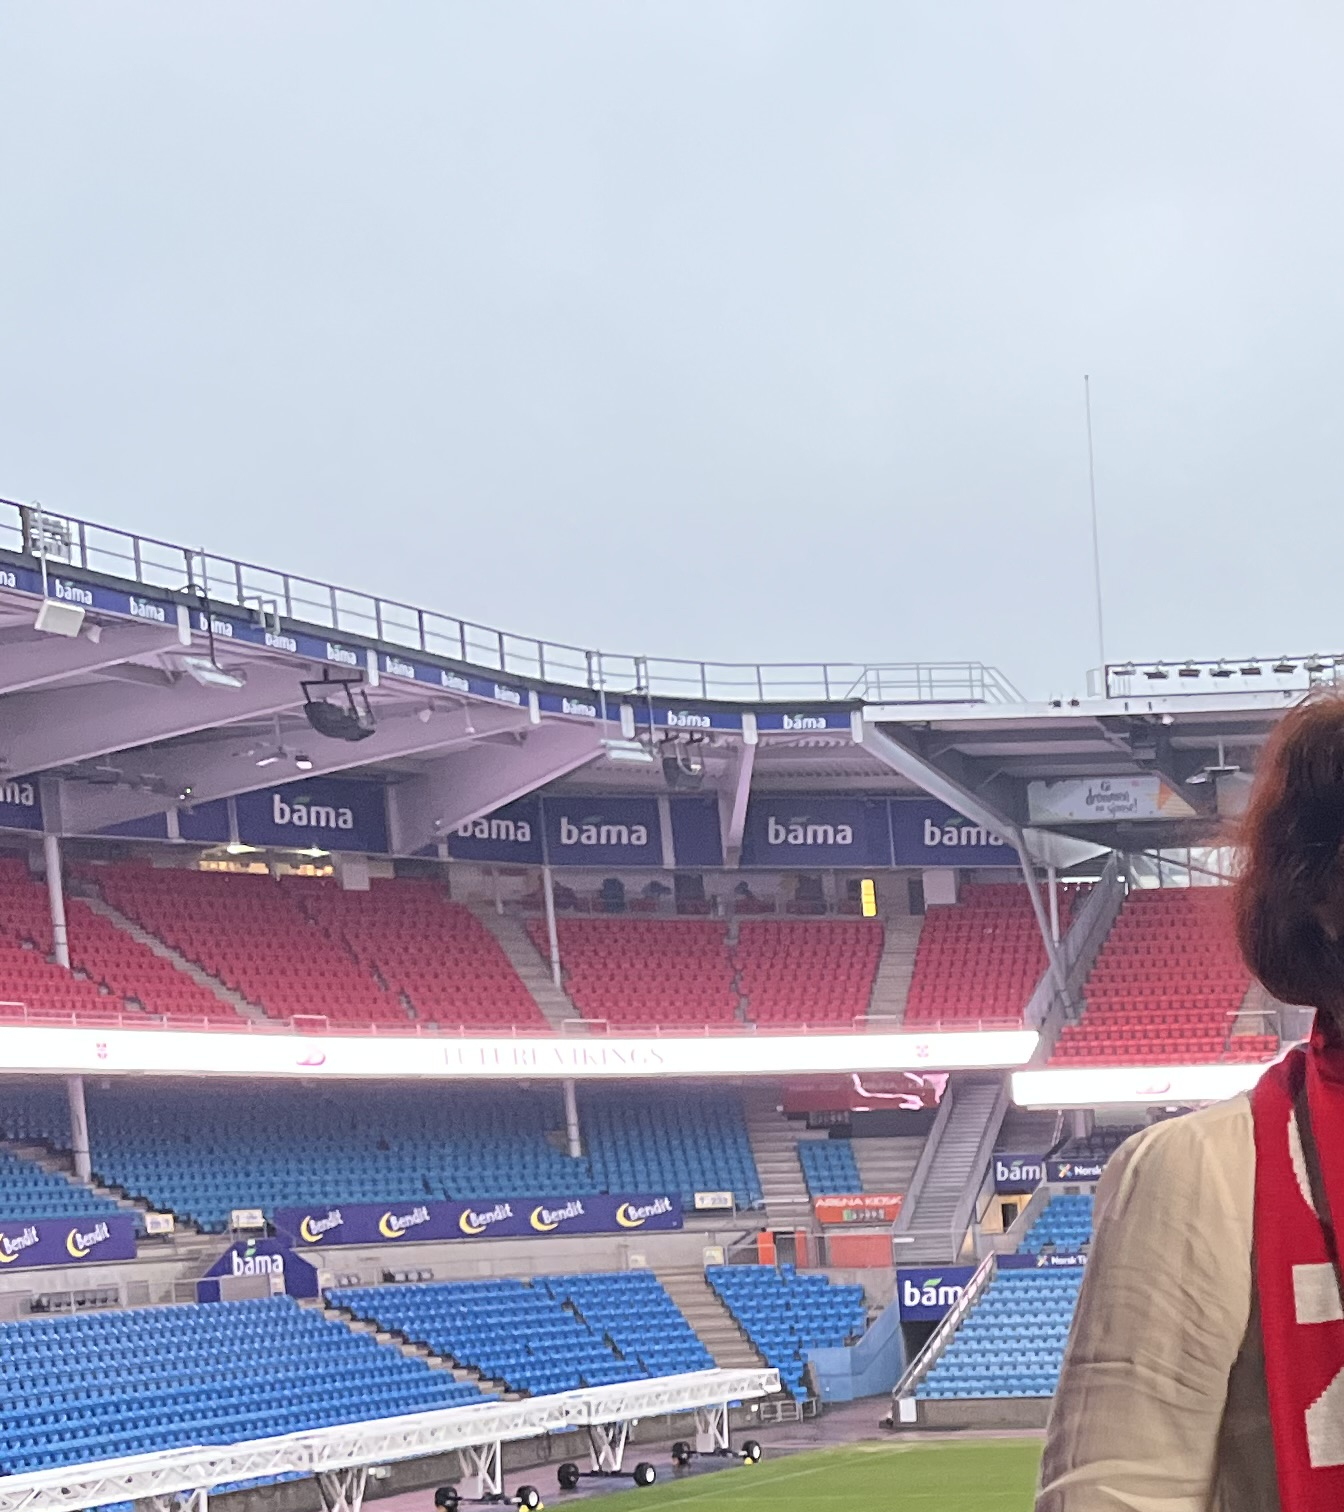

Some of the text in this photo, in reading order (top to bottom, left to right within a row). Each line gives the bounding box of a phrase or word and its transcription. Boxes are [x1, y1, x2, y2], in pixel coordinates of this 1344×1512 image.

[55, 579, 93, 605] bama
[129, 596, 165, 622] bama
[667, 710, 711, 728] bama
[782, 714, 827, 729] bama
[273, 793, 354, 829] bama
[560, 816, 648, 846] bama
[768, 816, 853, 846] bama
[996, 1161, 1042, 1182] bam
[309, 1208, 344, 1235] Bendit
[389, 1206, 431, 1231] Bendit
[470, 1203, 514, 1228] Bendit
[541, 1200, 585, 1225] Bendit
[628, 1196, 673, 1221] Bendit
[2, 1225, 39, 1255] Bendit
[74, 1221, 110, 1250] Bendit
[232, 1249, 284, 1276] bama
[904, 1280, 963, 1307] bam
